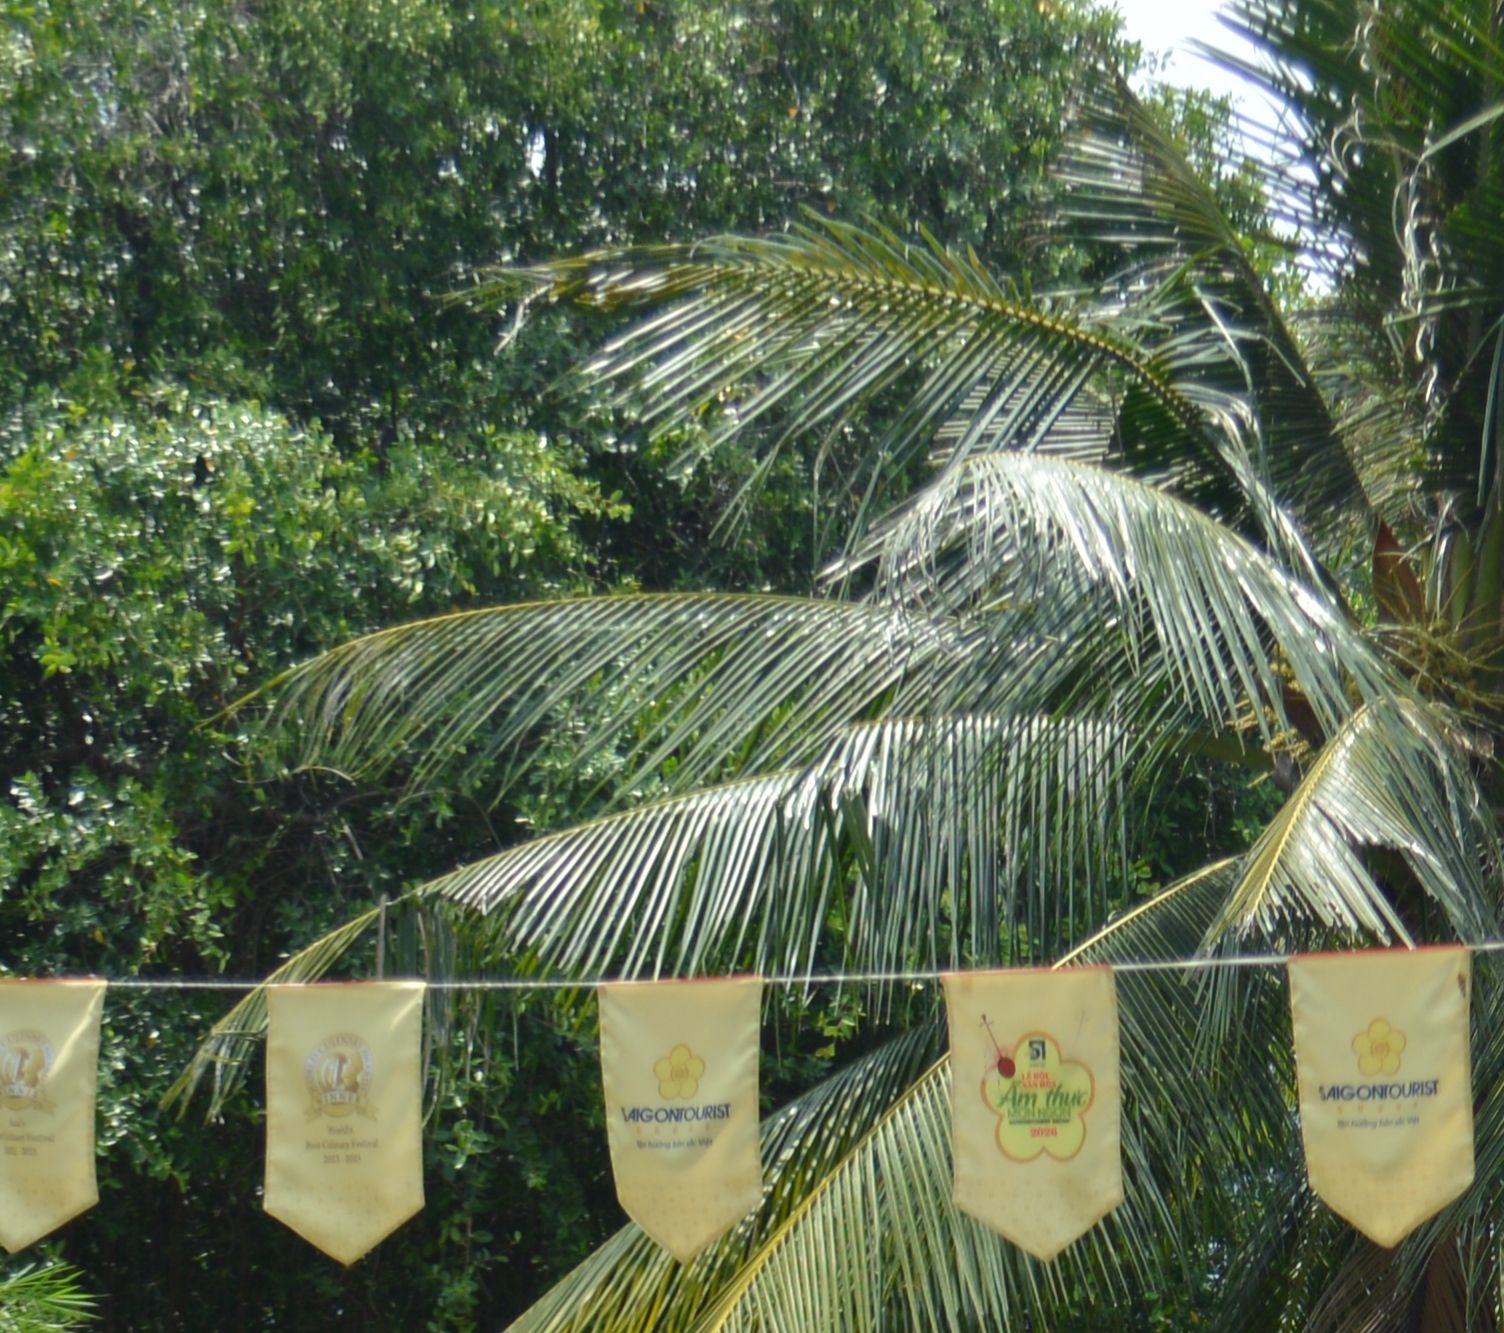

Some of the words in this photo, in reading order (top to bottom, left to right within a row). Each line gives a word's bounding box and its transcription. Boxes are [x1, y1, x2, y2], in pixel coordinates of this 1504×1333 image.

[997, 1080, 1037, 1109] Ẩm
[1319, 1079, 1440, 1101] SAIGONTOURIST
[1030, 1126, 1058, 1137] 2026
